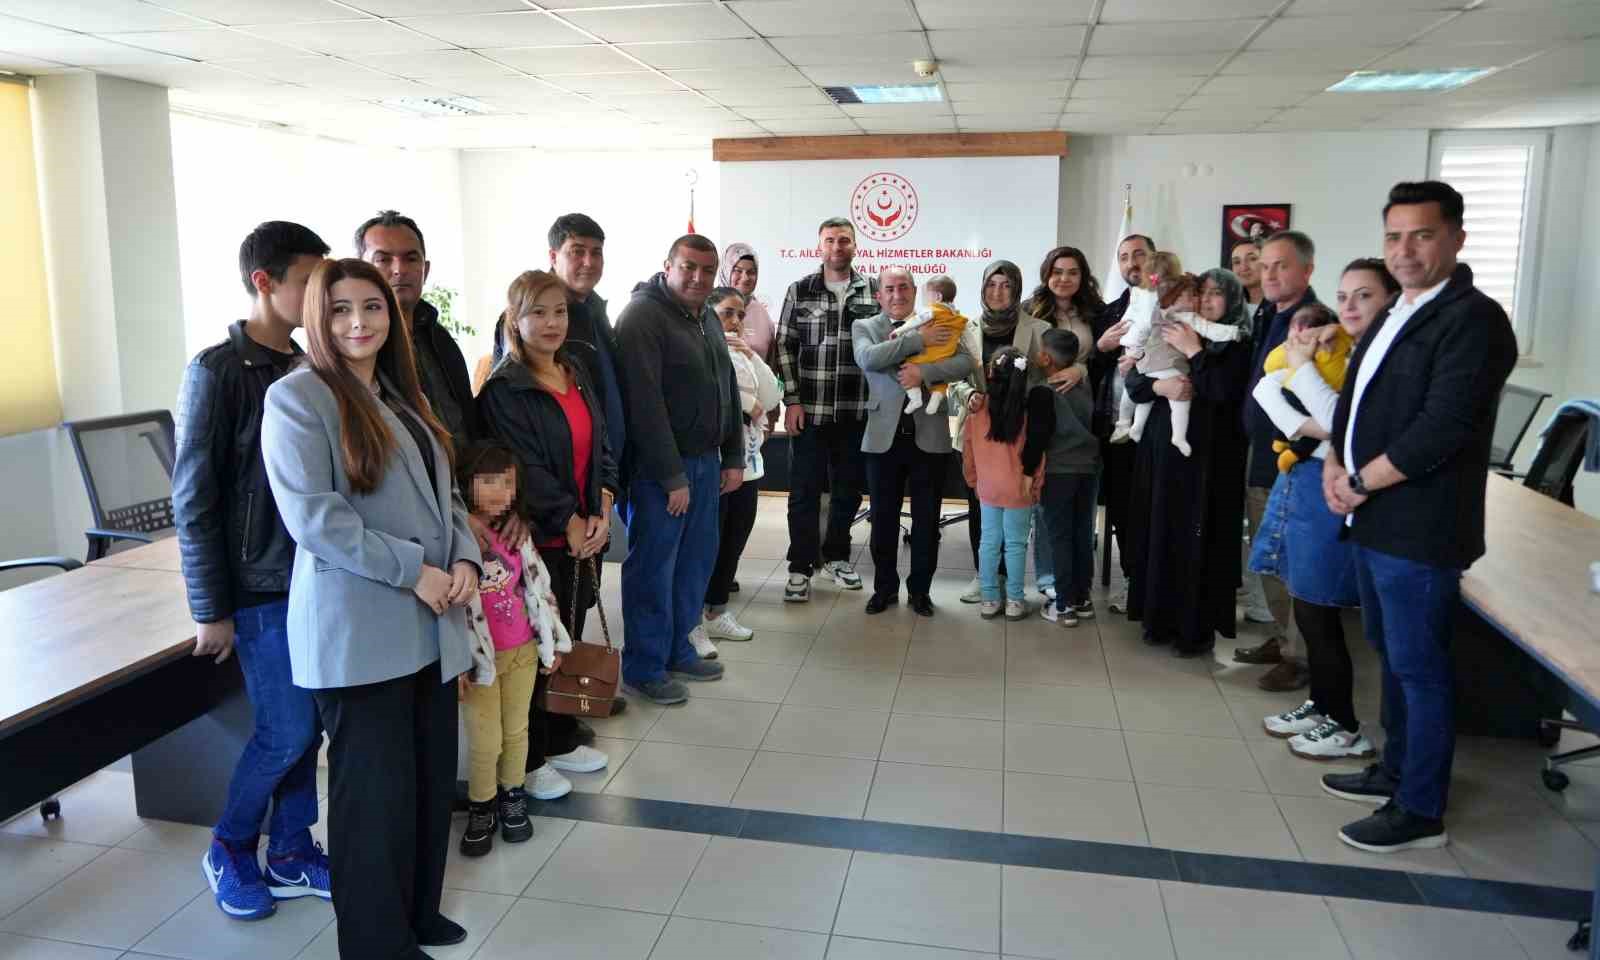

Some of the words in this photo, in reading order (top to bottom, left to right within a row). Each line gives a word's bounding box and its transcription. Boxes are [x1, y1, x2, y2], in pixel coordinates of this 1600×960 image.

[780, 249, 797, 258] T.C.
[799, 248, 822, 258] AİLE
[877, 248, 933, 258] HİZMETLER
[936, 248, 992, 258] BAKANLIĞI
